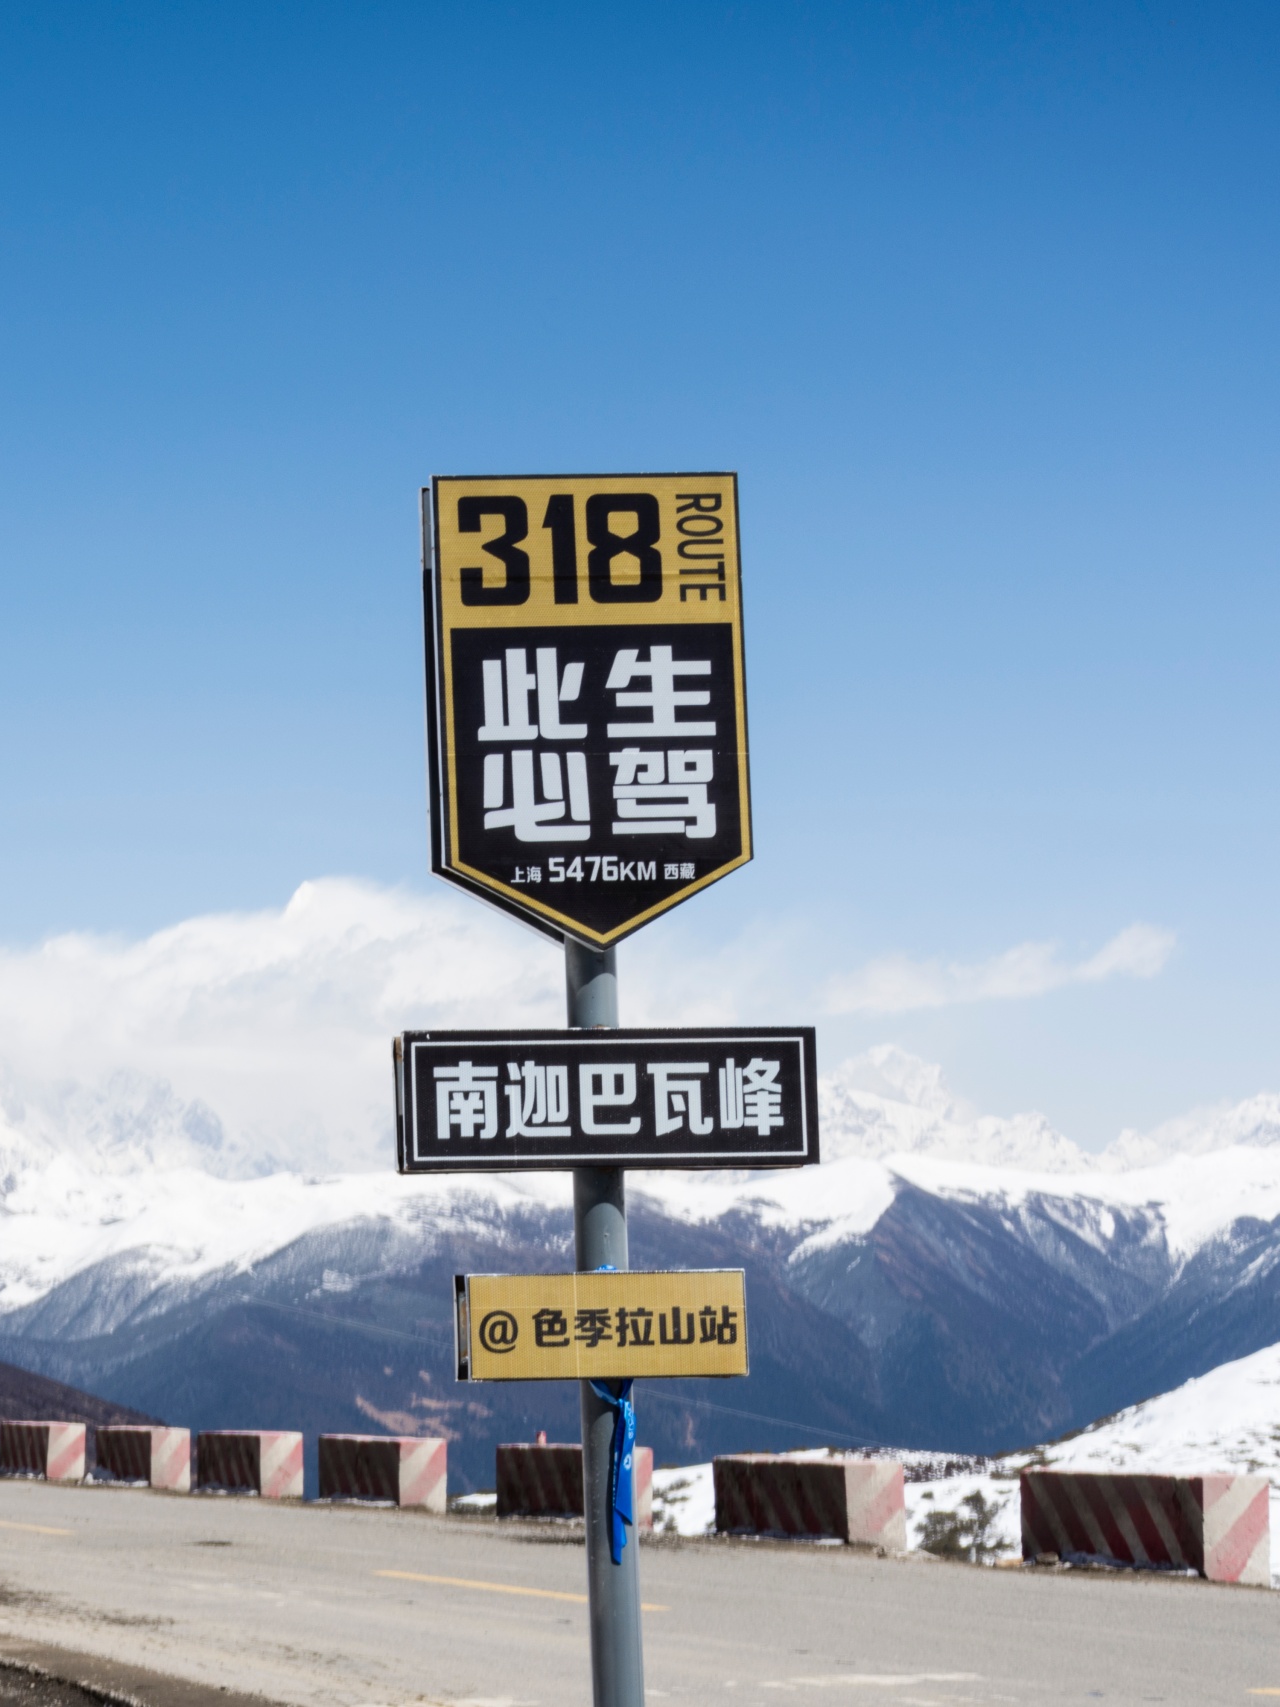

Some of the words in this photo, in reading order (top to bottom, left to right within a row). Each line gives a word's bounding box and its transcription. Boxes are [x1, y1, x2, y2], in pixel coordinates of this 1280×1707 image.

[458, 493, 663, 606] 318
[675, 492, 726, 603] ROUTE
[478, 645, 717, 741] 此生
[483, 747, 718, 842] 必驾
[510, 866, 542, 883] 上海
[548, 856, 656, 883] 5476KM
[663, 863, 696, 880] 西藏
[433, 1057, 784, 1139] 南迦巴瓦峰
[531, 1305, 738, 1348] 色季拉山站
